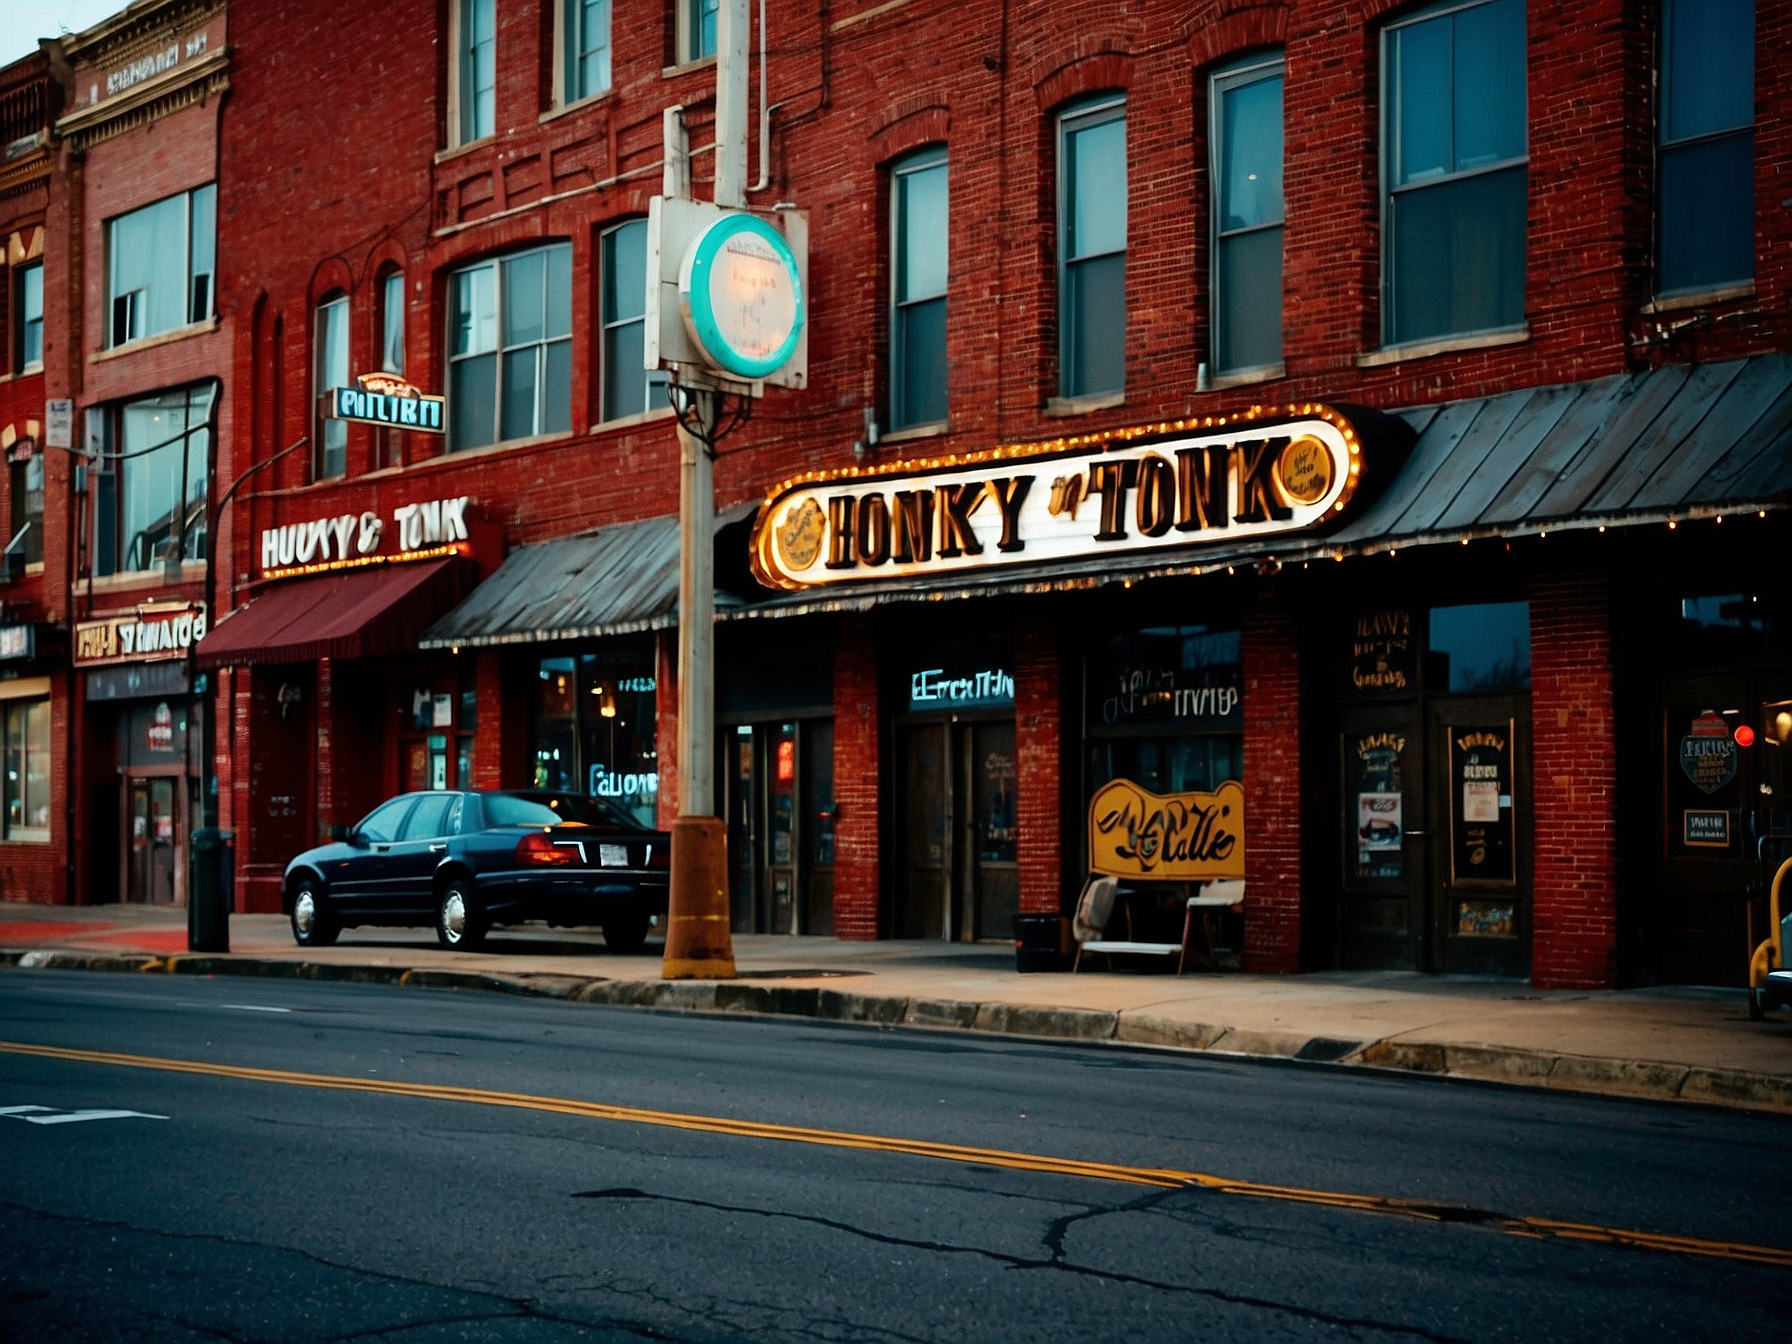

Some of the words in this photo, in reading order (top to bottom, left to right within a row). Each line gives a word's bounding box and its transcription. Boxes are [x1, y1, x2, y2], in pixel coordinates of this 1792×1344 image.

[394, 496, 469, 551] TONK
[825, 475, 1036, 570] HONKY
[1089, 436, 1293, 542] TONK
